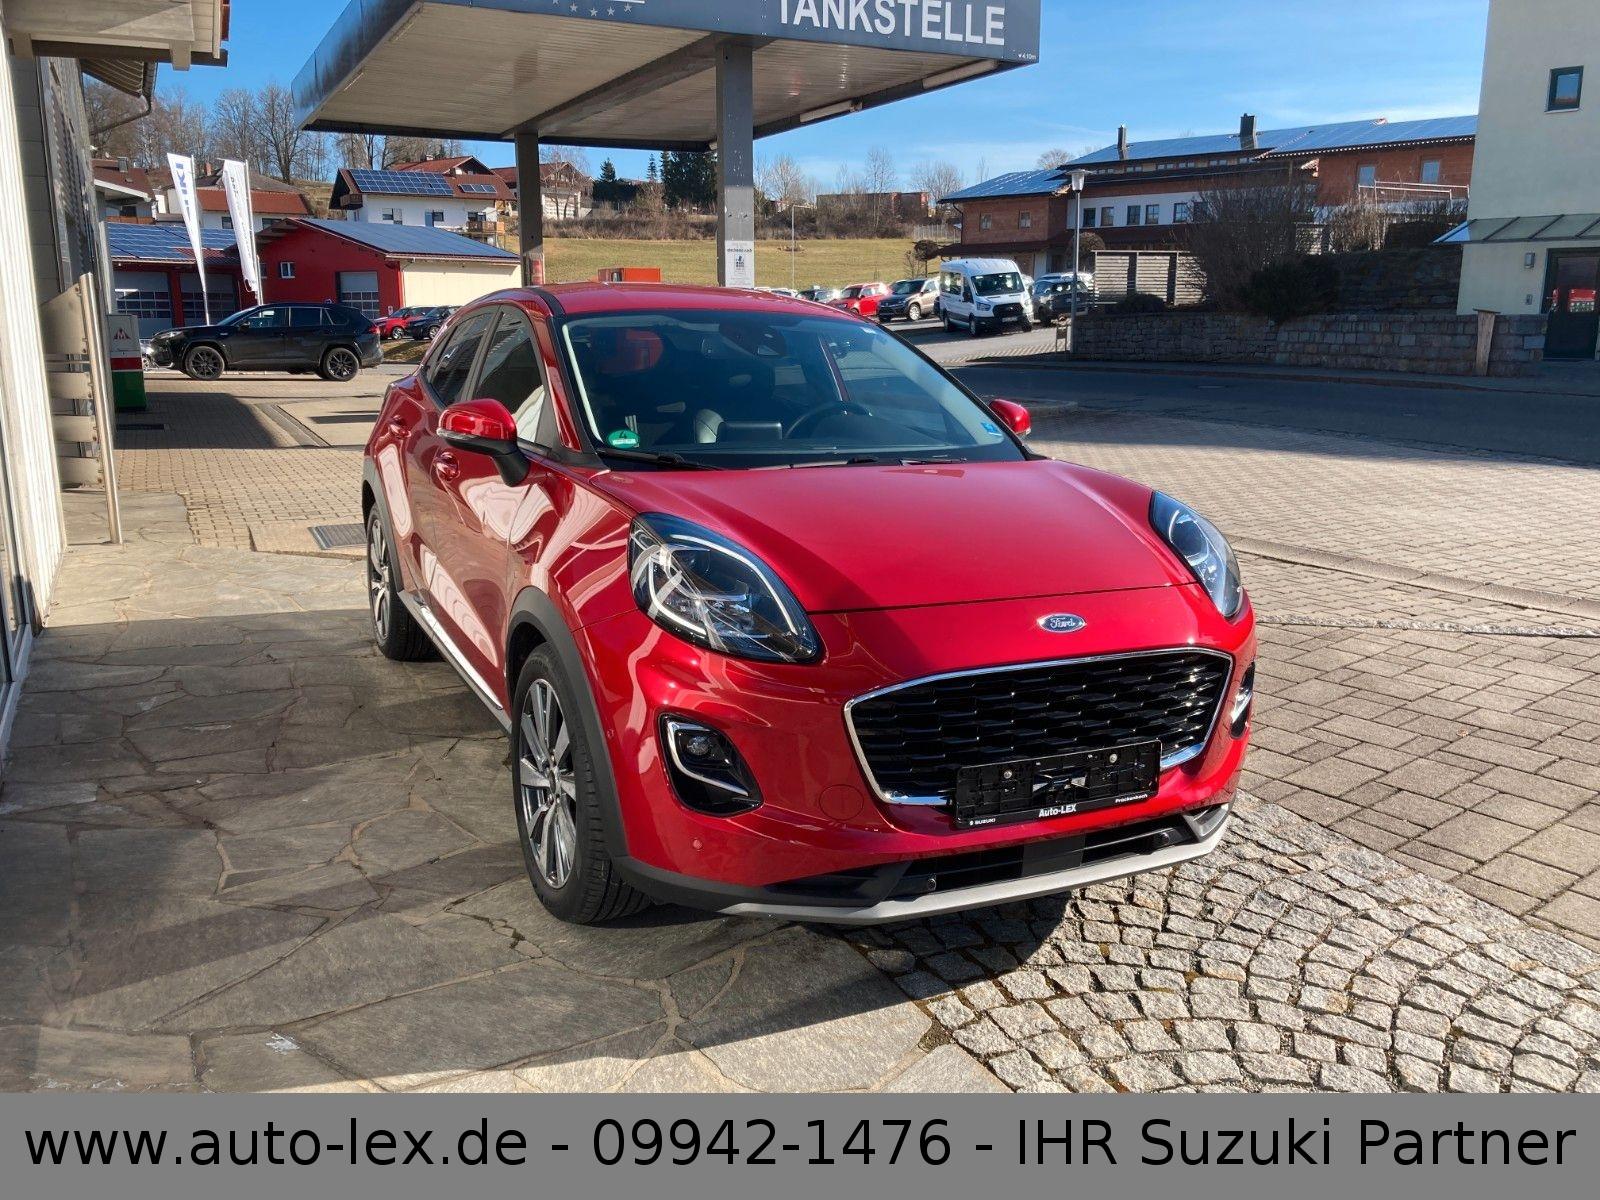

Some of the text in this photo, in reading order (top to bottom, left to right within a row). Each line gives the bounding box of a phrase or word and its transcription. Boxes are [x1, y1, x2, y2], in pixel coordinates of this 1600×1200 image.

[781, 0, 1005, 46] TANKSTELLE
[1050, 616, 1076, 629] Ford
[1038, 803, 1077, 818] Auto-LEX
[974, 818, 996, 826] SUZUKI
